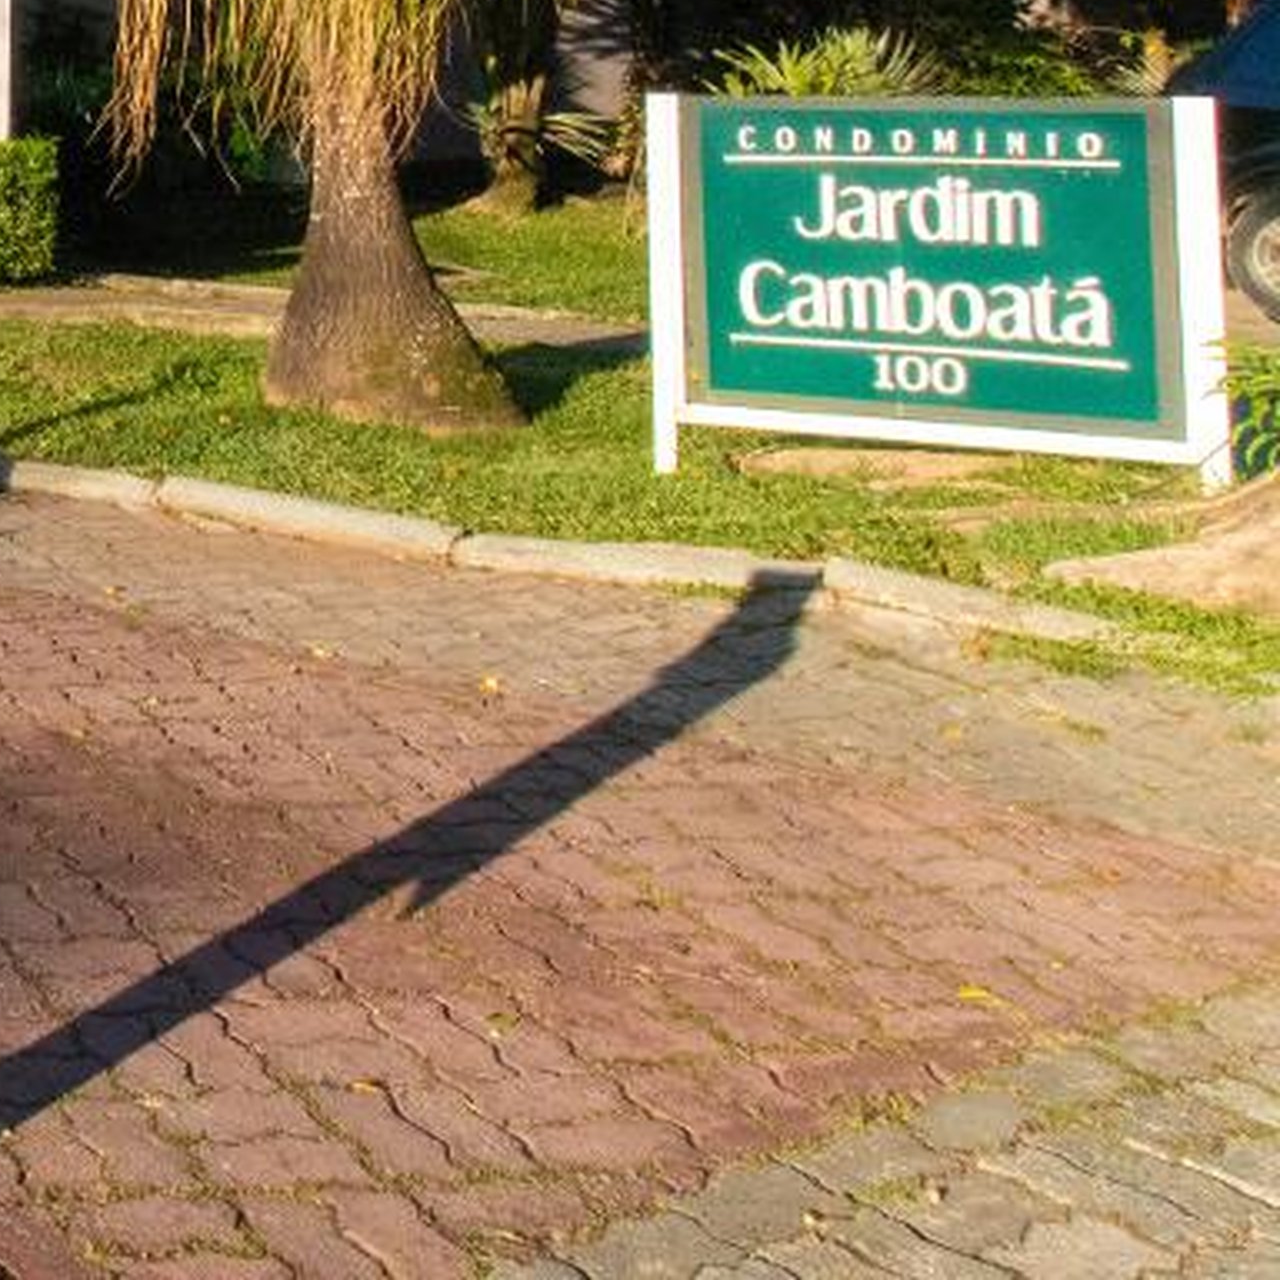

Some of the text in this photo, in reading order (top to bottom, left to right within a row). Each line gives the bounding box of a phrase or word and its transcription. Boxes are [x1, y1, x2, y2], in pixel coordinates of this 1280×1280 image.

[738, 124, 1104, 159] CONDOMINIO
[794, 172, 1040, 248] Jardim
[739, 259, 1112, 348] Camboatá
[873, 353, 967, 395] 100
